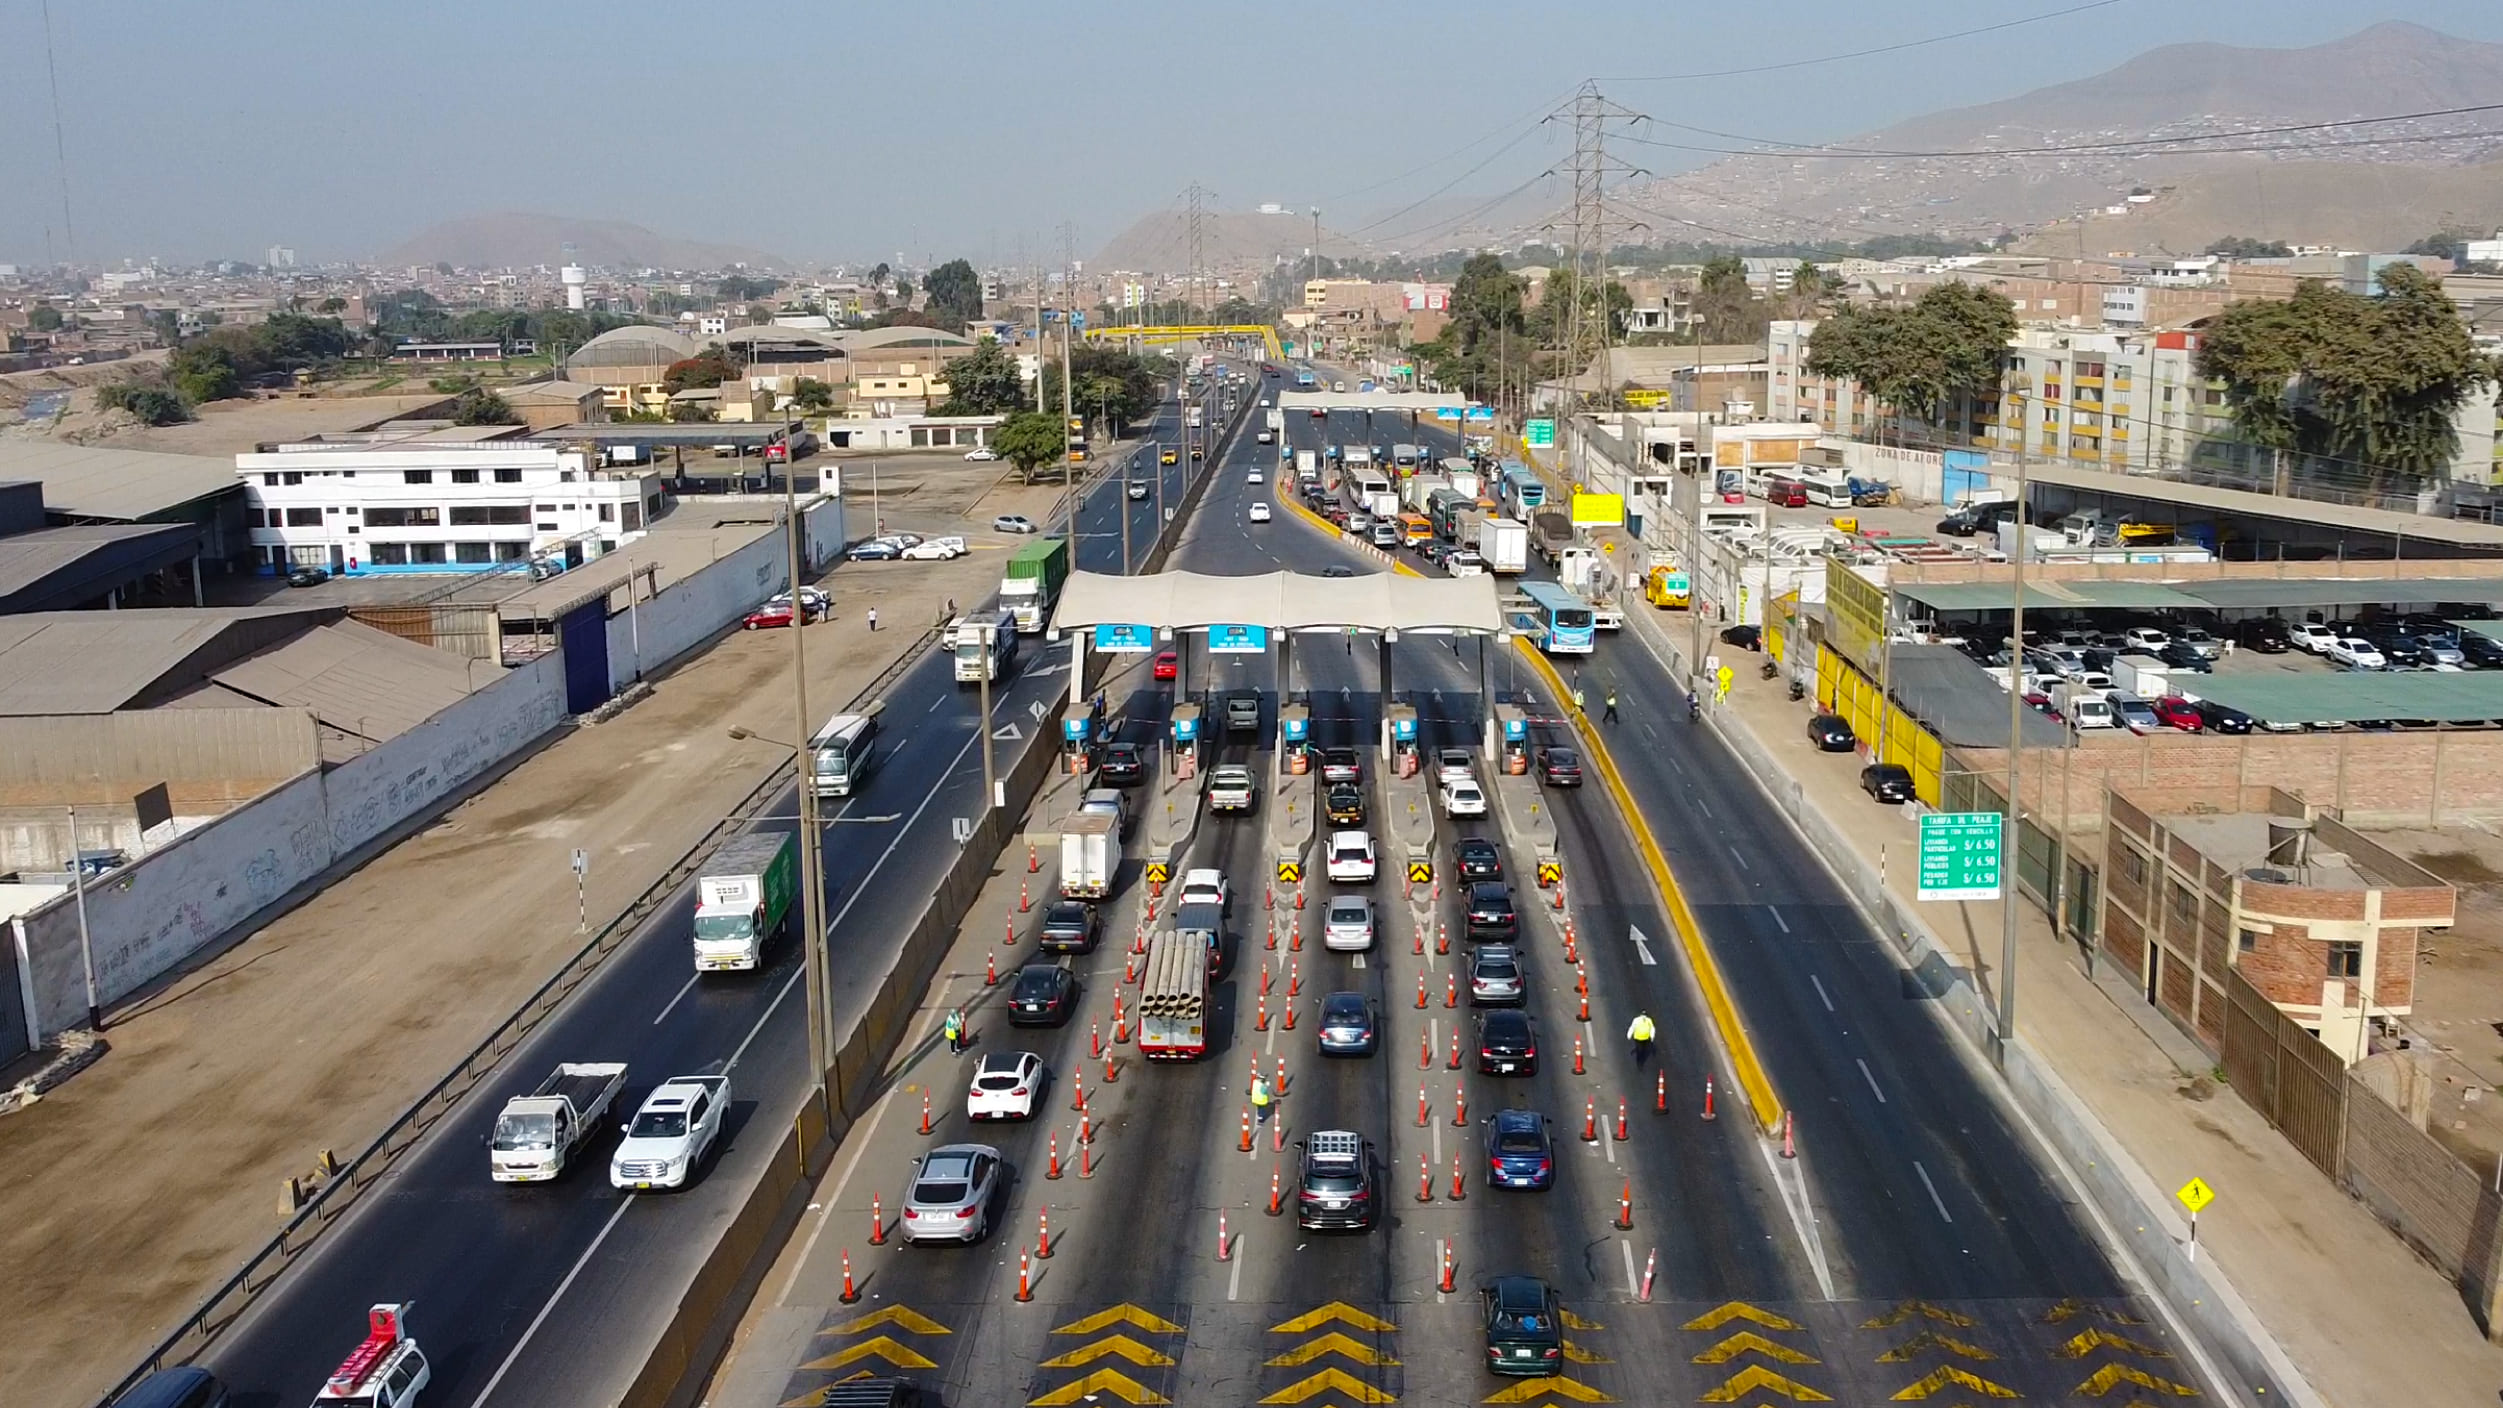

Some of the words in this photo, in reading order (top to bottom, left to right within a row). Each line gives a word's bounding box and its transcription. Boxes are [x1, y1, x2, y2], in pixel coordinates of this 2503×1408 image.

[1875, 448, 1897, 460] ZONA
[1901, 451, 1911, 462] DE
[1971, 816, 1993, 824] PEAJE
[1963, 839, 1975, 851] S/
[1976, 838, 1995, 850] 6.50
[1963, 856, 1975, 867] S/
[1976, 855, 1995, 867] 6.50
[1963, 873, 1974, 884] S/
[1976, 872, 1995, 884] 6.50
